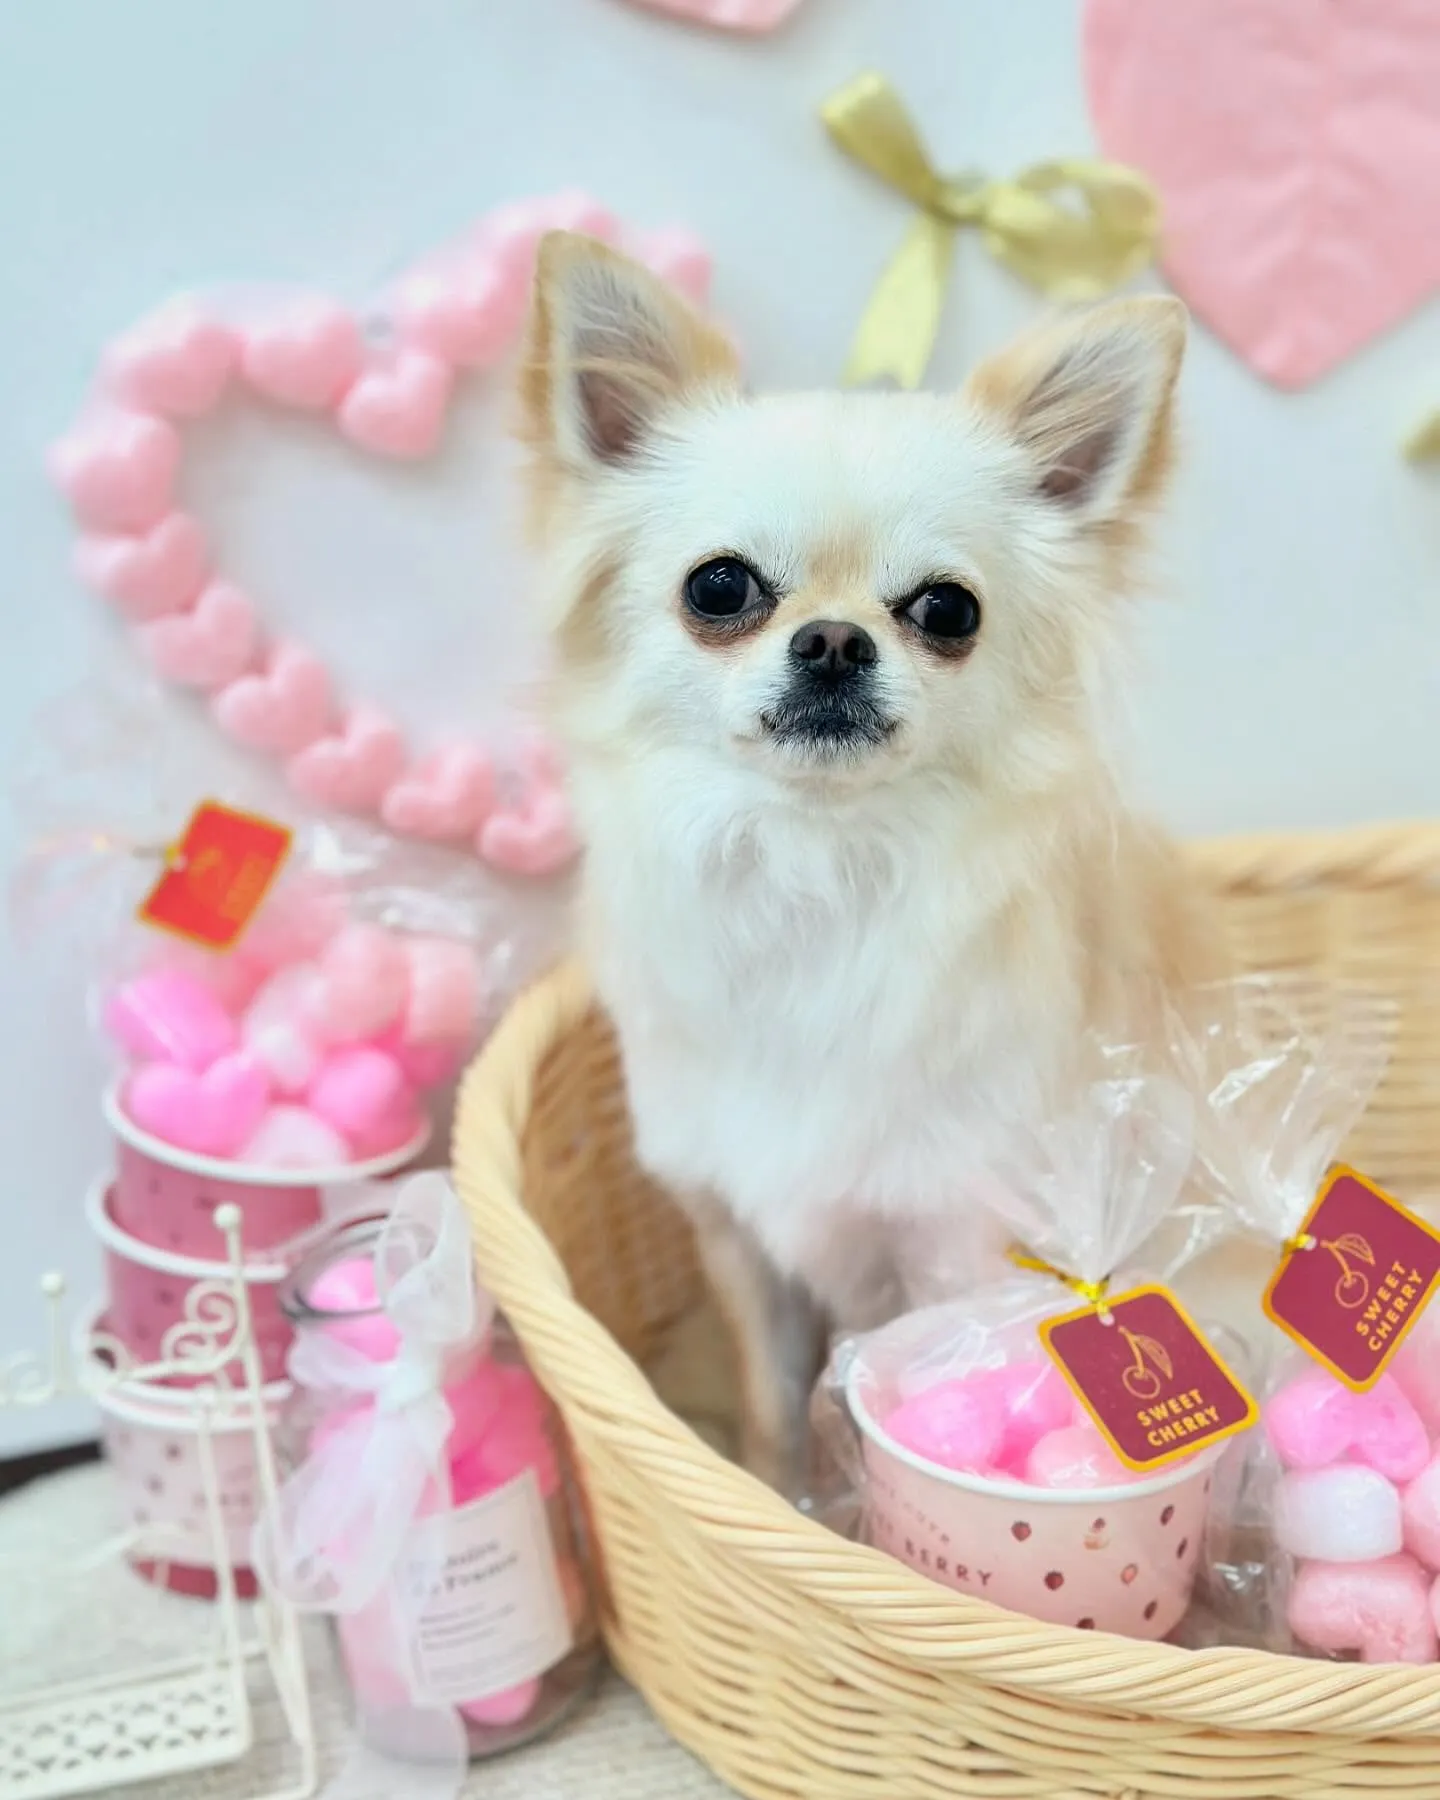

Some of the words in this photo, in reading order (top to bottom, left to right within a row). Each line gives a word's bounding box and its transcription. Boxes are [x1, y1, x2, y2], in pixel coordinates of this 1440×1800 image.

[1356, 1261, 1405, 1336] SWEET
[1368, 1268, 1422, 1351] CHERRY
[1137, 1388, 1203, 1427] SWEET
[1147, 1405, 1219, 1447] CHERRY
